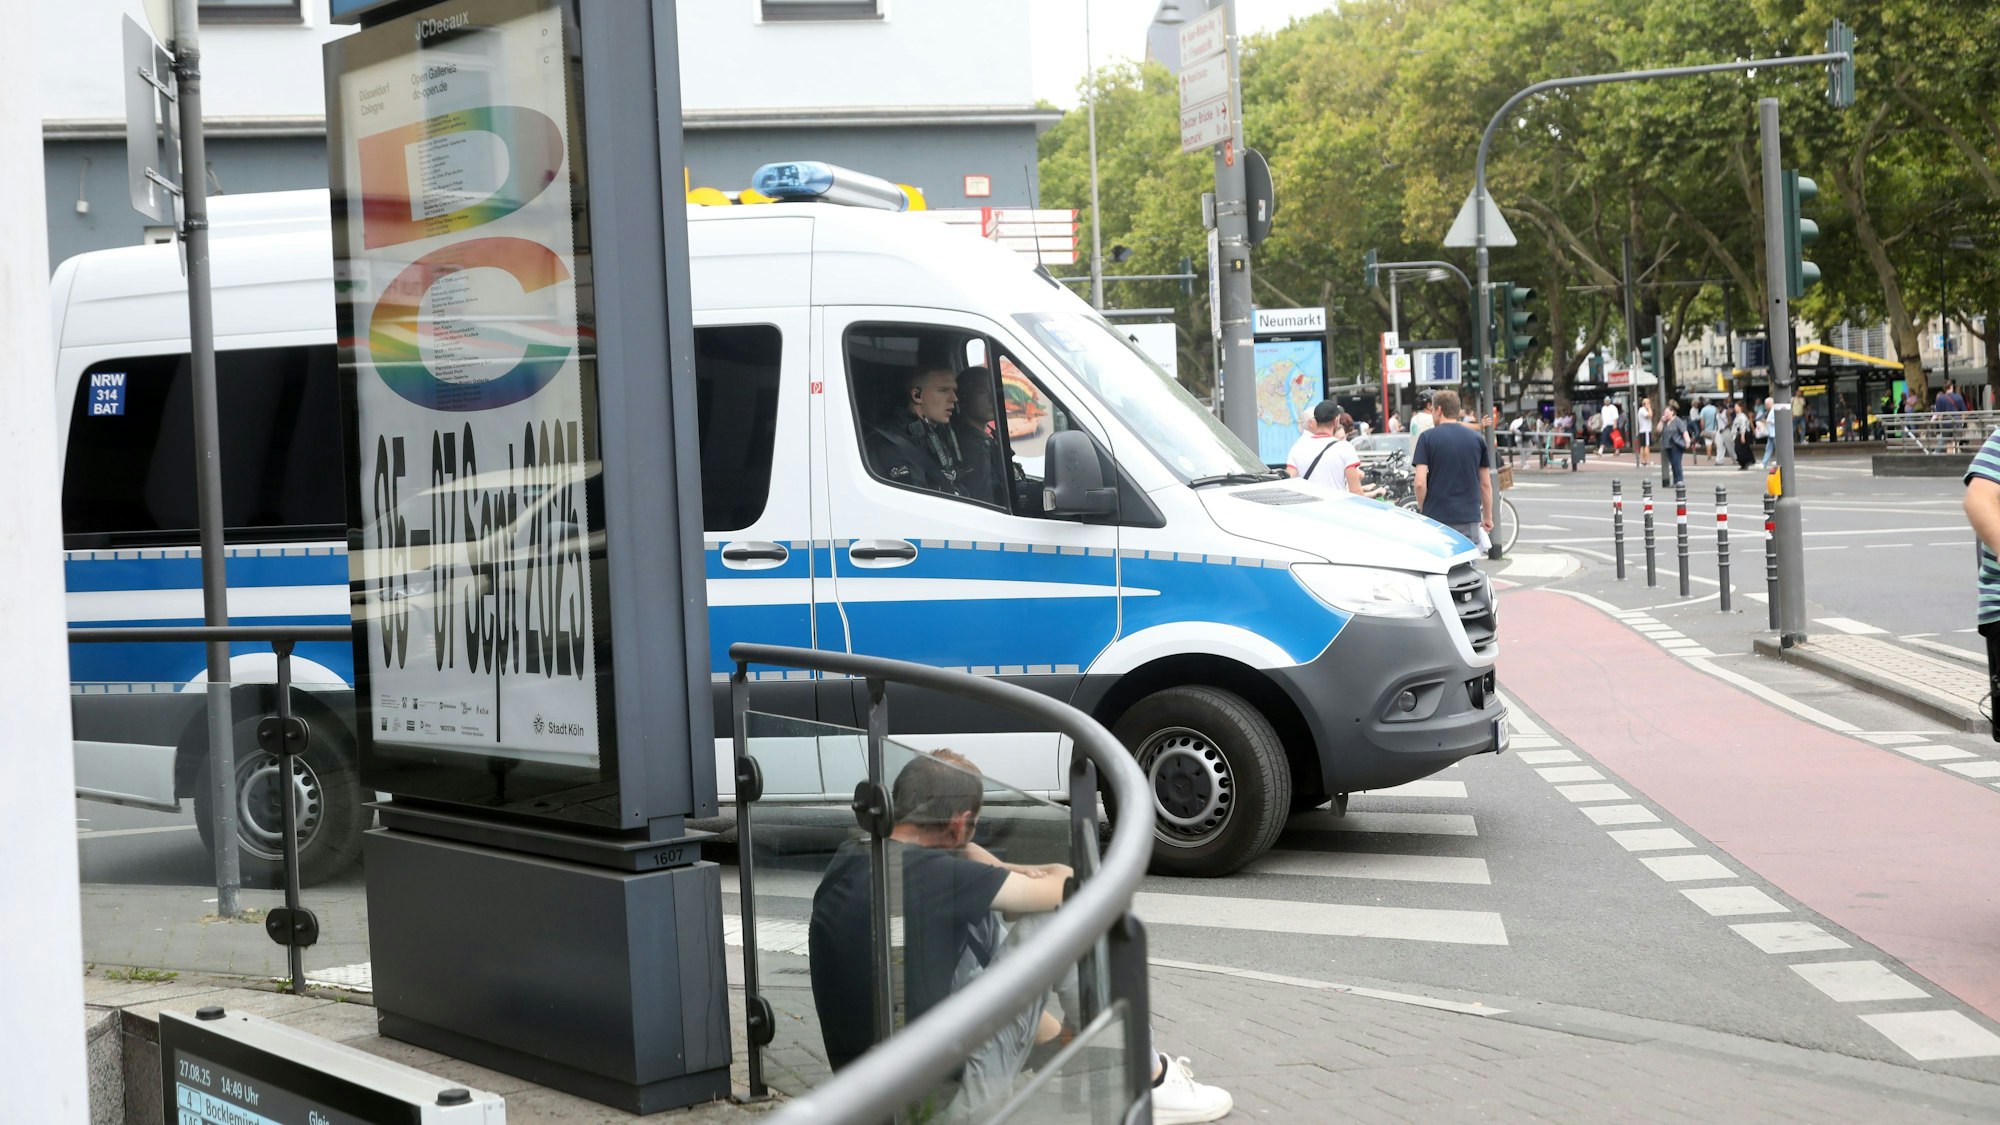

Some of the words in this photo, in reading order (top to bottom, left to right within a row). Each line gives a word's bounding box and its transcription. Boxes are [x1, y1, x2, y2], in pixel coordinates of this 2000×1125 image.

[415, 12, 470, 40] JCDecaux
[410, 72, 428, 86] Open
[428, 64, 456, 79] Galleries
[359, 82, 390, 101] Düsseldorf
[412, 80, 448, 100] dc-open.de
[361, 102, 384, 116] Cologne
[1260, 313, 1321, 327] Neumarkt
[91, 373, 125, 387] NRW
[96, 389, 118, 400] 314
[94, 403, 119, 414] BAT
[524, 418, 585, 680] 2025
[548, 722, 567, 736] Stadt
[568, 723, 584, 736] Köln
[653, 848, 684, 866] 1607
[180, 1060, 211, 1087] 27.08.25
[221, 1076, 243, 1101] 14:49
[244, 1085, 259, 1106] Uhr
[187, 1092, 192, 1108] 4
